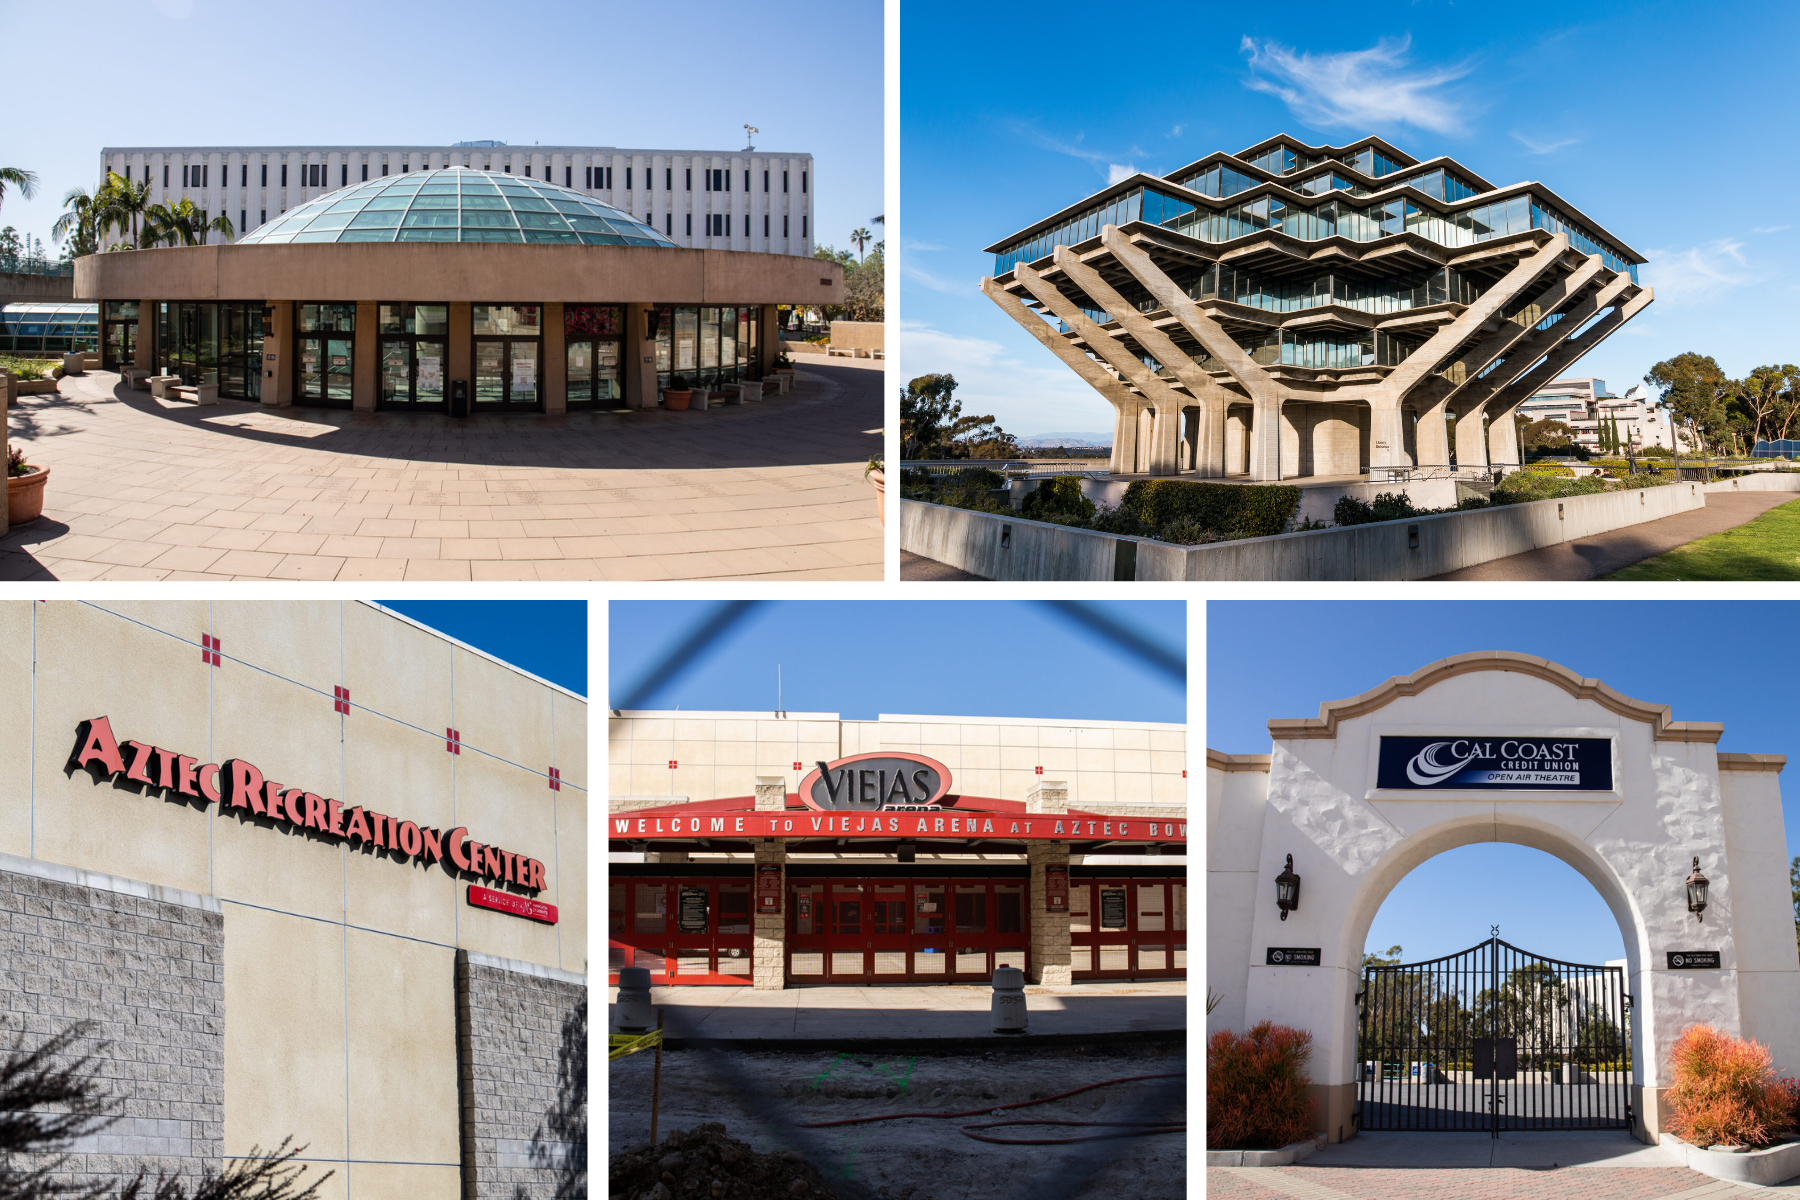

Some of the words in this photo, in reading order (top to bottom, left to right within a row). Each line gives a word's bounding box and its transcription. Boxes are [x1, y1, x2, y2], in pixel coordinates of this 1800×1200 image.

[1501, 761, 1538, 770] CREDIT
[1544, 762, 1579, 771] UNION
[1487, 773, 1513, 781] OPEN
[1535, 774, 1576, 782] THEATRE
[815, 761, 931, 811] VIEJAS
[615, 817, 745, 834] WELCOME
[770, 820, 793, 832] TO
[811, 817, 899, 832] VIEJAS
[917, 818, 994, 833] ARENA
[1011, 822, 1032, 834] AT
[1055, 820, 1128, 835] AZTEC
